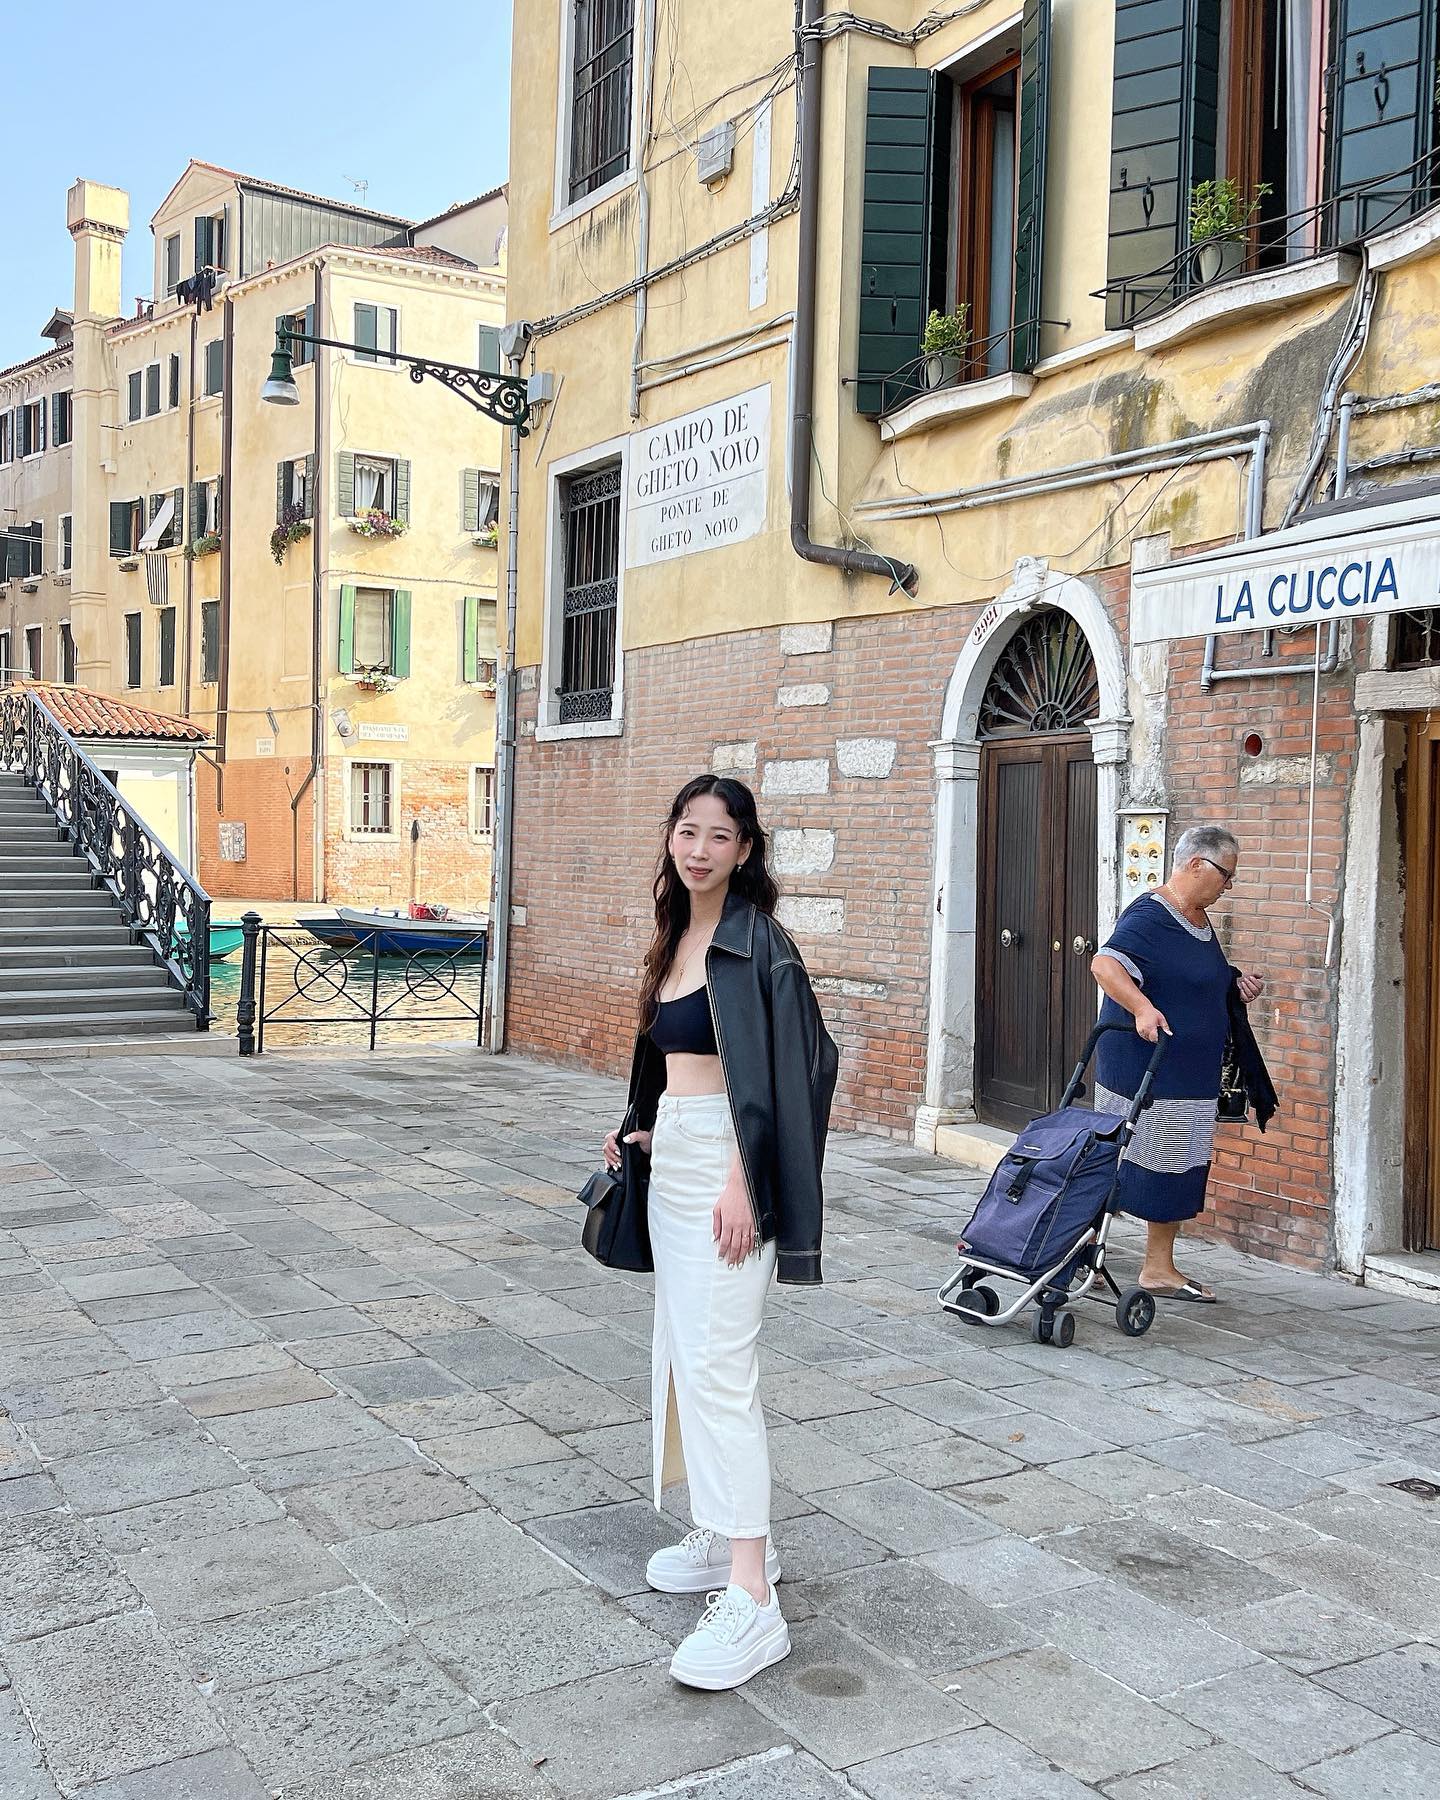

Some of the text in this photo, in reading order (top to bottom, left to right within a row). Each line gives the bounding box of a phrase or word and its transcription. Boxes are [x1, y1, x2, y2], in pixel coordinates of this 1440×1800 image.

[648, 402, 750, 462] CAMPO DE
[637, 435, 760, 498] GHETO NOVO
[661, 488, 730, 523] PONTE DE
[651, 516, 739, 553] GHETO NOVO
[1215, 557, 1400, 624] LA CUCCIA
[974, 605, 998, 642] 2921
